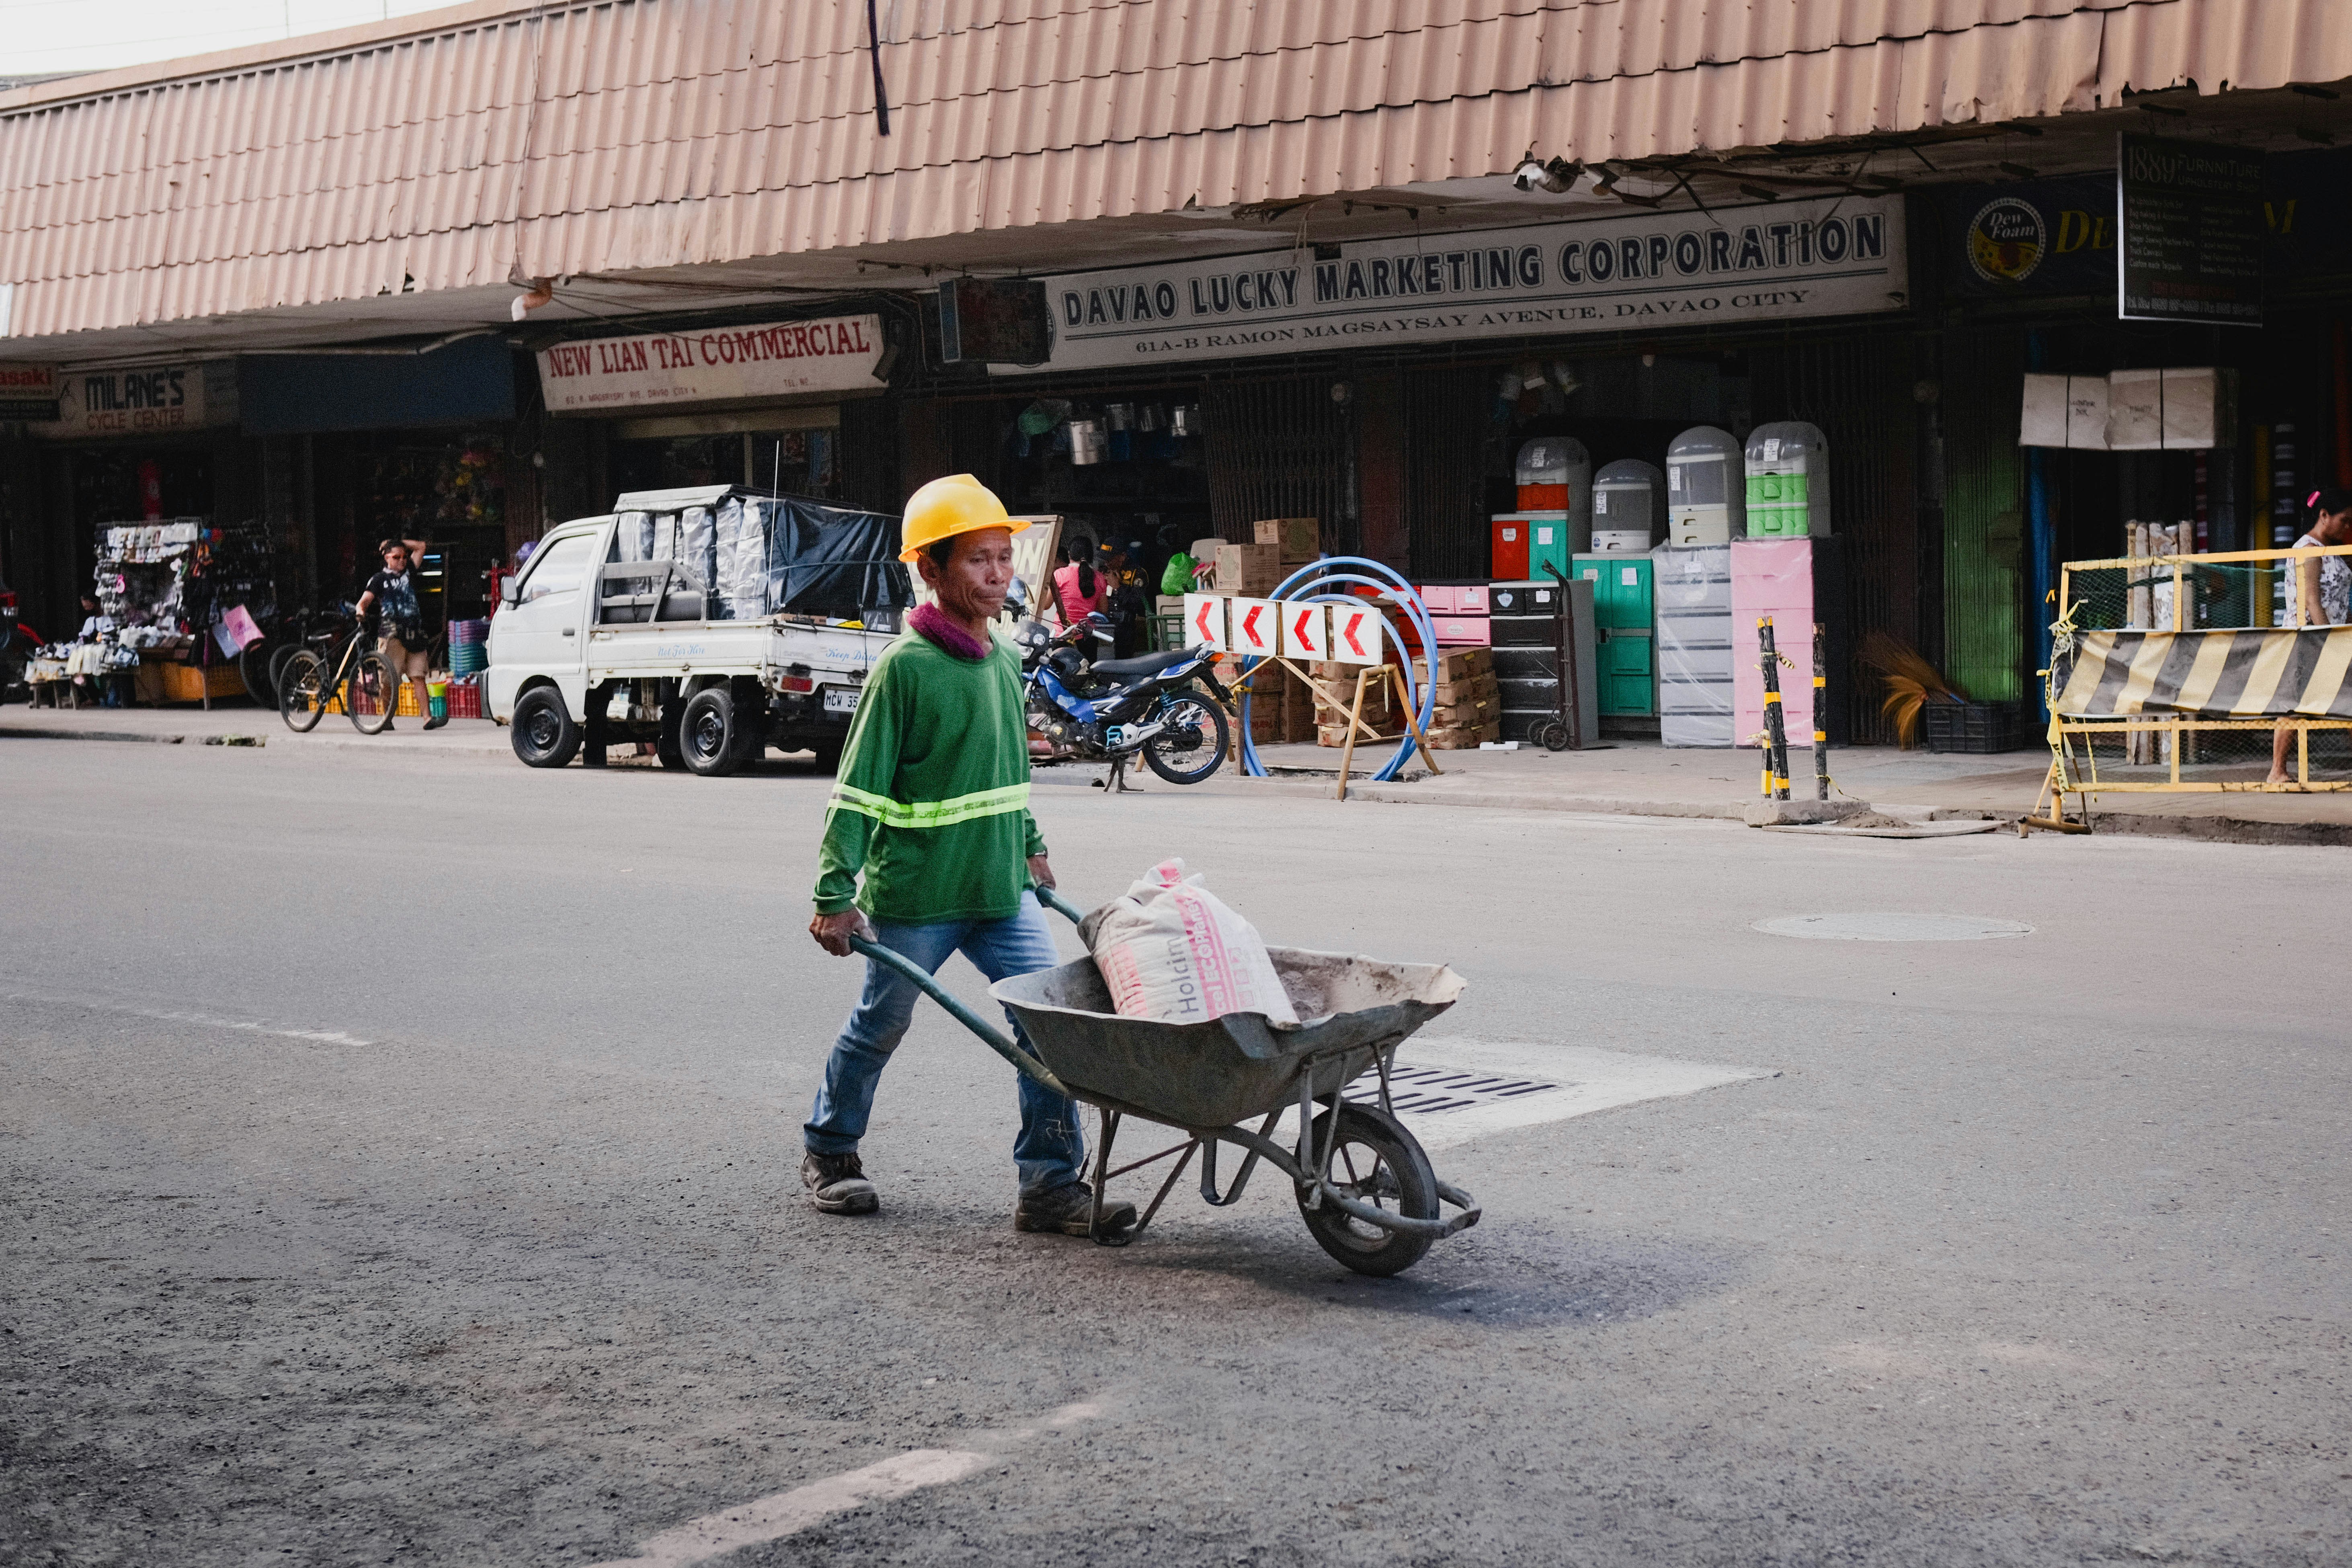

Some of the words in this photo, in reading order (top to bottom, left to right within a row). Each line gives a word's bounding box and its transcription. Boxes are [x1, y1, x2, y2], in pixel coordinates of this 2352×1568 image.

[1989, 212, 2024, 226] Dew
[1991, 225, 2036, 239] Foam
[1062, 281, 1177, 327] DAVAO
[1189, 268, 1299, 316] LUCKY
[1314, 247, 1543, 303] MARKETING
[1560, 214, 1884, 283] CORPORATION
[1136, 334, 1199, 353] 61A-B
[1207, 329, 1294, 347] RAMON
[1303, 315, 1469, 338] MAGSAYSAY
[1478, 306, 1604, 325] AVENUE,
[1614, 298, 1721, 317] DAVAO
[1731, 290, 1809, 307] CITY
[548, 344, 592, 378] NEW
[599, 340, 649, 374] LIAN
[651, 337, 695, 369] TAI
[700, 321, 871, 366] COMMERCIAL
[85, 367, 185, 411] MILANE'S
[87, 412, 125, 431] CYCLE
[133, 409, 185, 427] CENTER
[658, 646, 671, 656] Not
[673, 644, 685, 657] For
[826, 648, 849, 662] Keep
[826, 694, 842, 707] MCW
[1167, 937, 1199, 1014] Holcim
